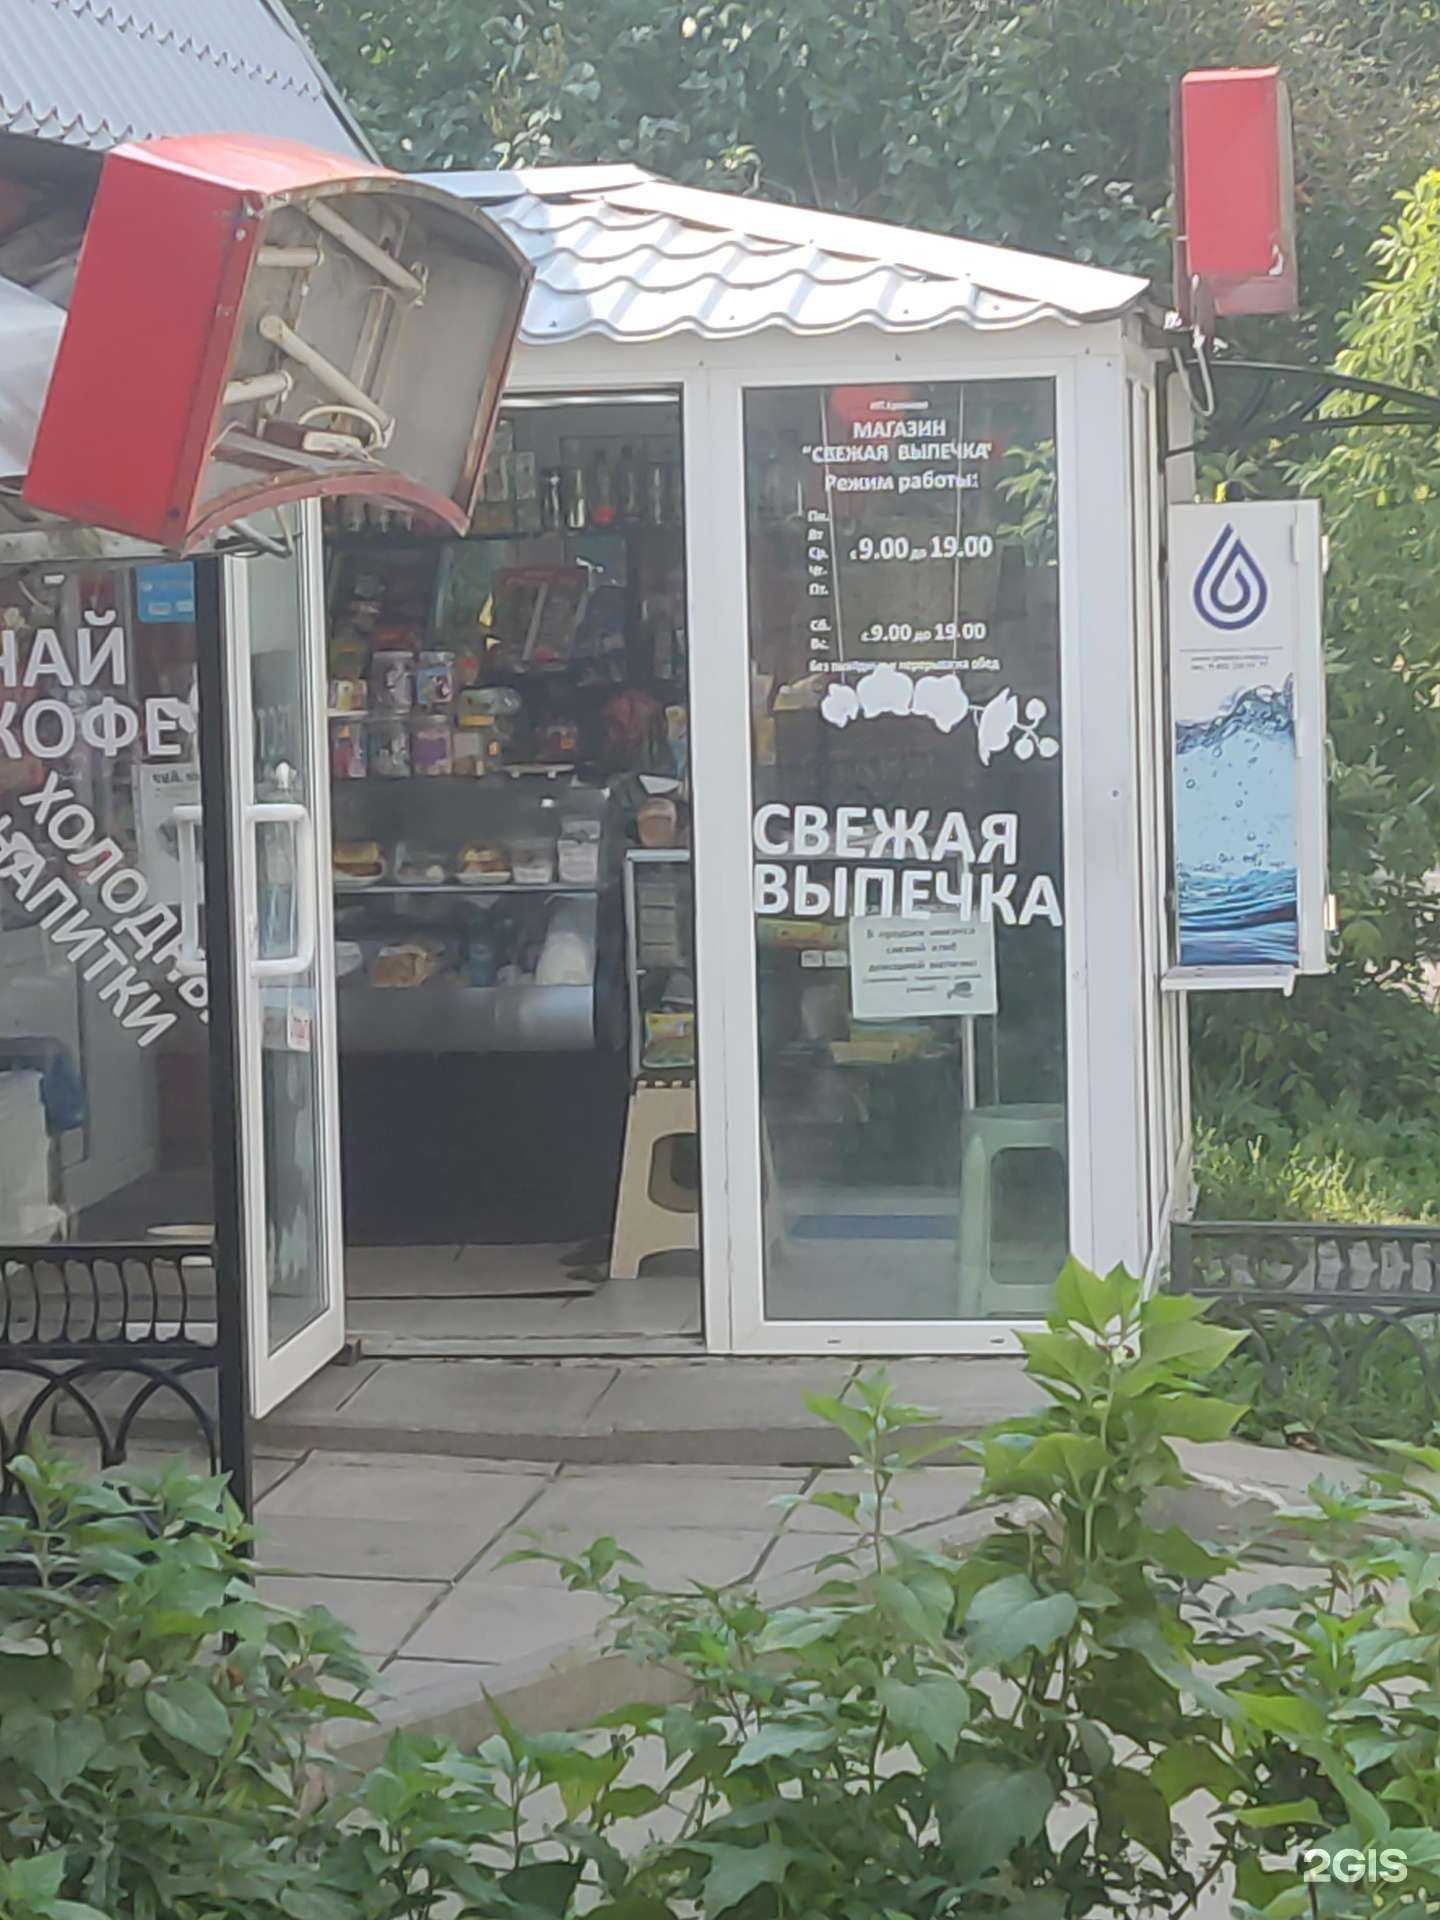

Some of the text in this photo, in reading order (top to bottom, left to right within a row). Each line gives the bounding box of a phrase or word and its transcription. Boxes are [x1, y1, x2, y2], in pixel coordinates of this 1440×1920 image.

[853, 419, 946, 438] МАГАЗИН
[825, 474, 894, 492] Режим
[858, 536, 910, 560] 9.00
[930, 534, 994, 558] 19.00
[870, 624, 912, 642] 9.00
[934, 622, 987, 641] 19.00
[753, 803, 1018, 865] СВЕЖАЯ
[753, 863, 1063, 927] ВЫПЕЧКА
